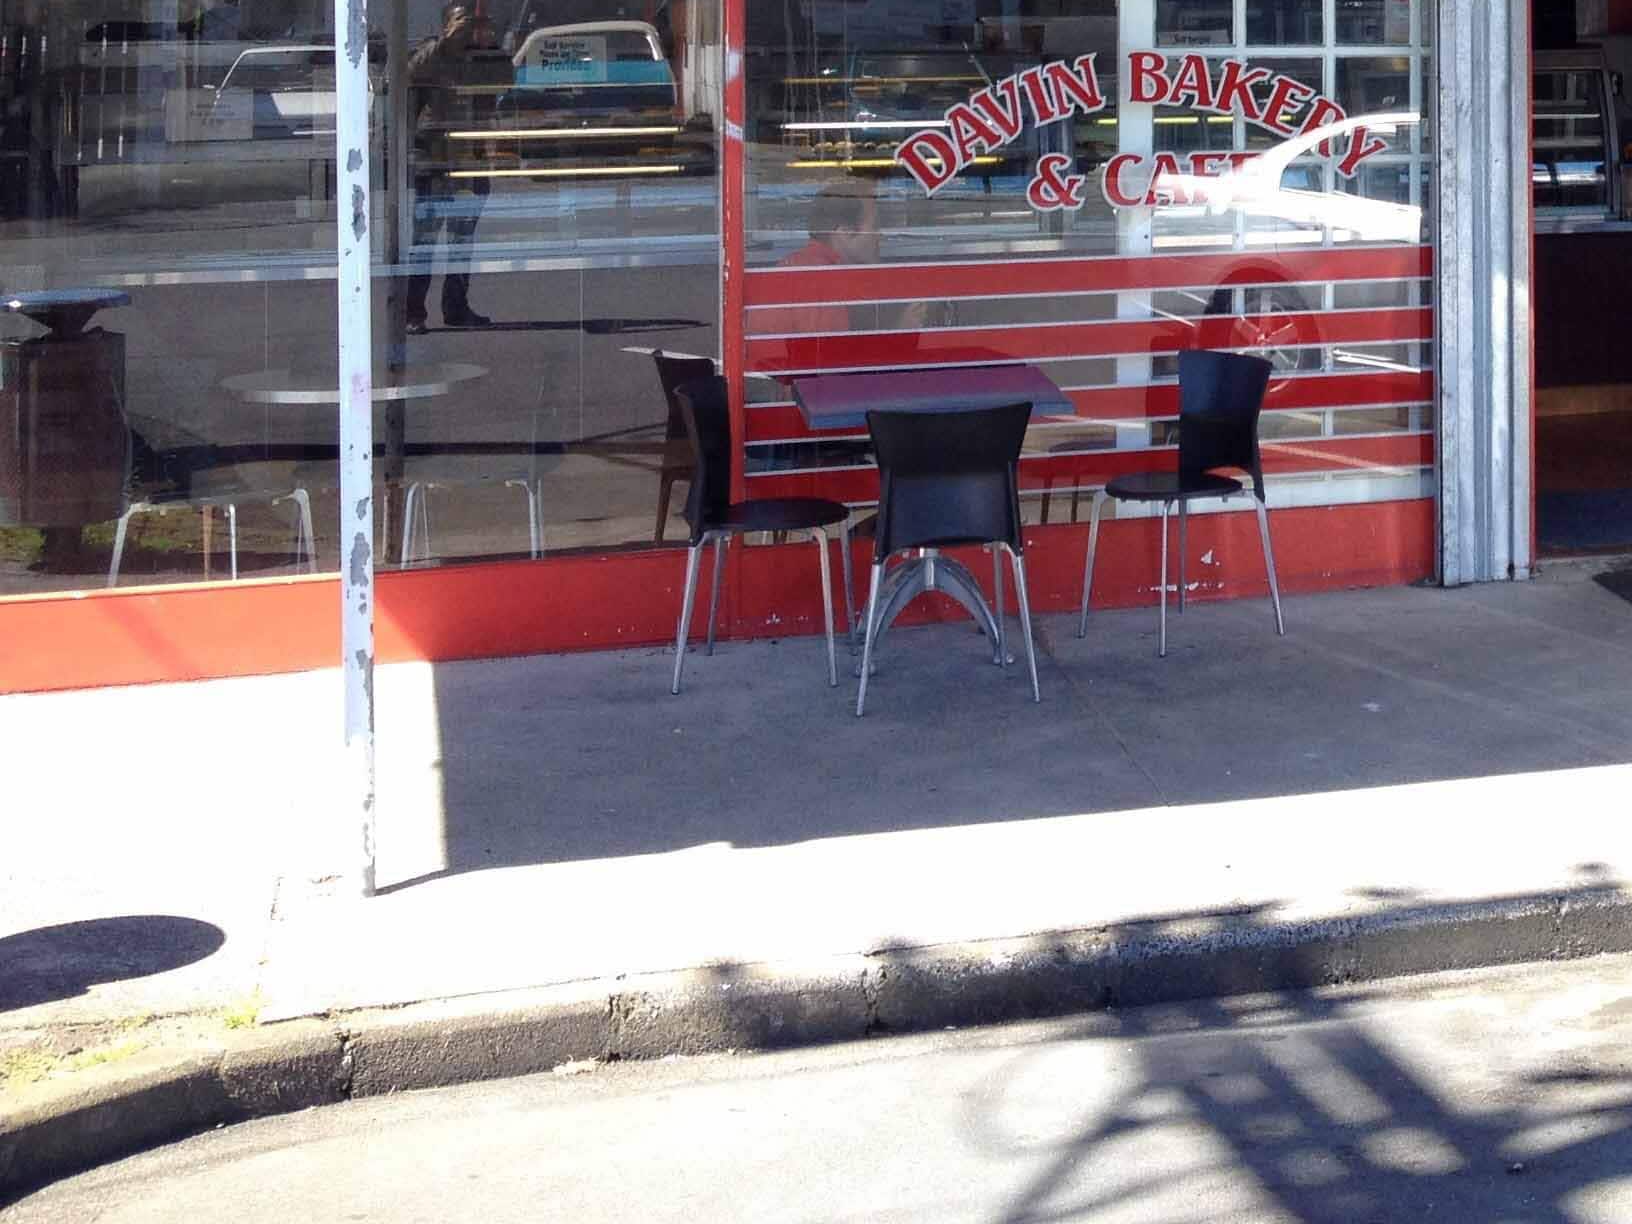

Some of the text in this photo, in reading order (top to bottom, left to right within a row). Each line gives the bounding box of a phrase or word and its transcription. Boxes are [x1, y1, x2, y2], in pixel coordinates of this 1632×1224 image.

[895, 51, 1387, 197] DAVIN BAKERY
[1026, 152, 1085, 210] &
